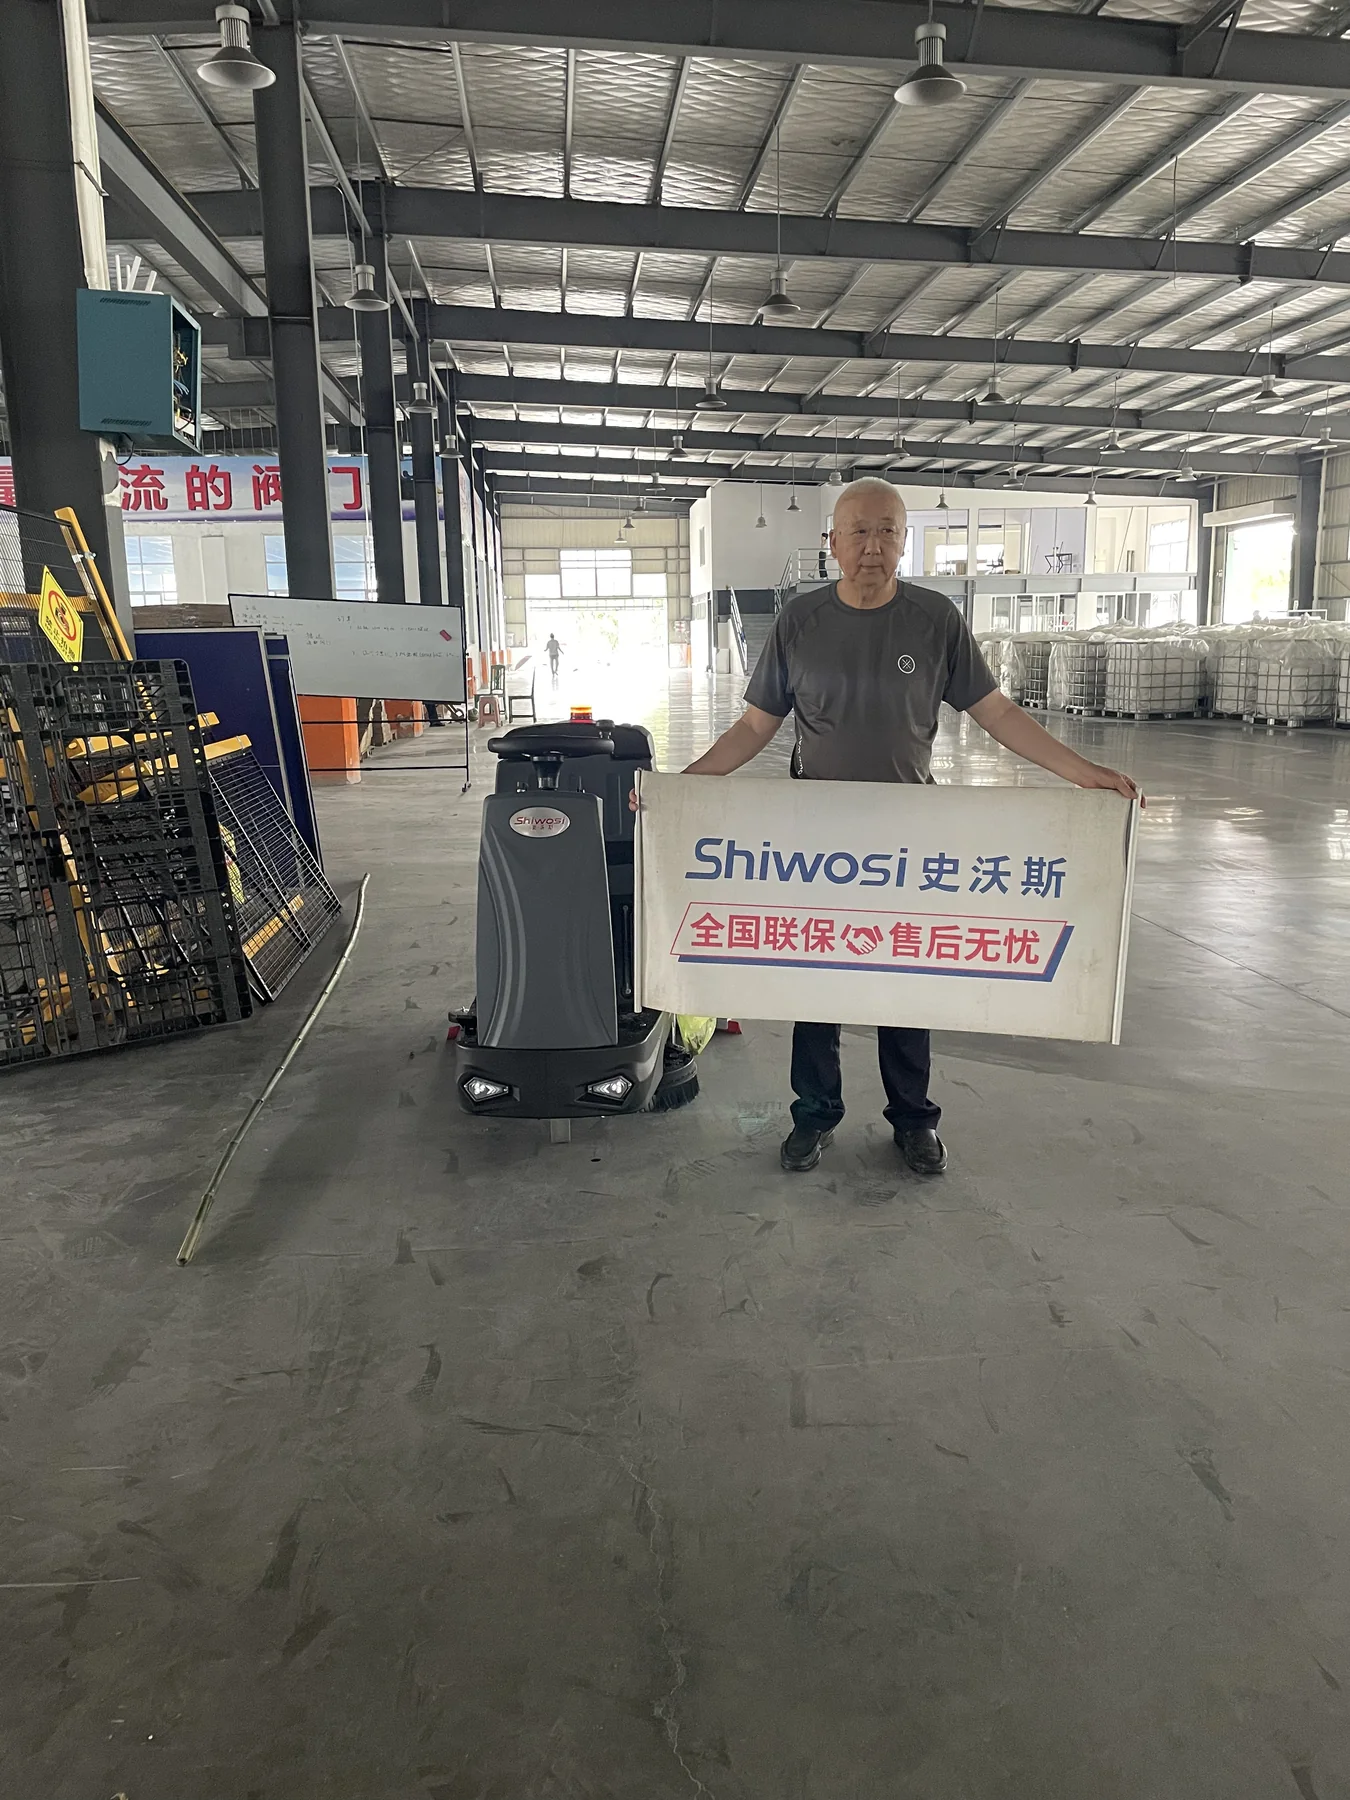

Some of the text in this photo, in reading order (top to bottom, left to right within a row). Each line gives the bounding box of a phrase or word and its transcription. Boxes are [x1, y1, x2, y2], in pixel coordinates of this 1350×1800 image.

[514, 816, 565, 825] Shiwosi
[685, 838, 1067, 899] Shiwosi 史沃斯
[689, 912, 1041, 965] 全国联保 售后无忧
